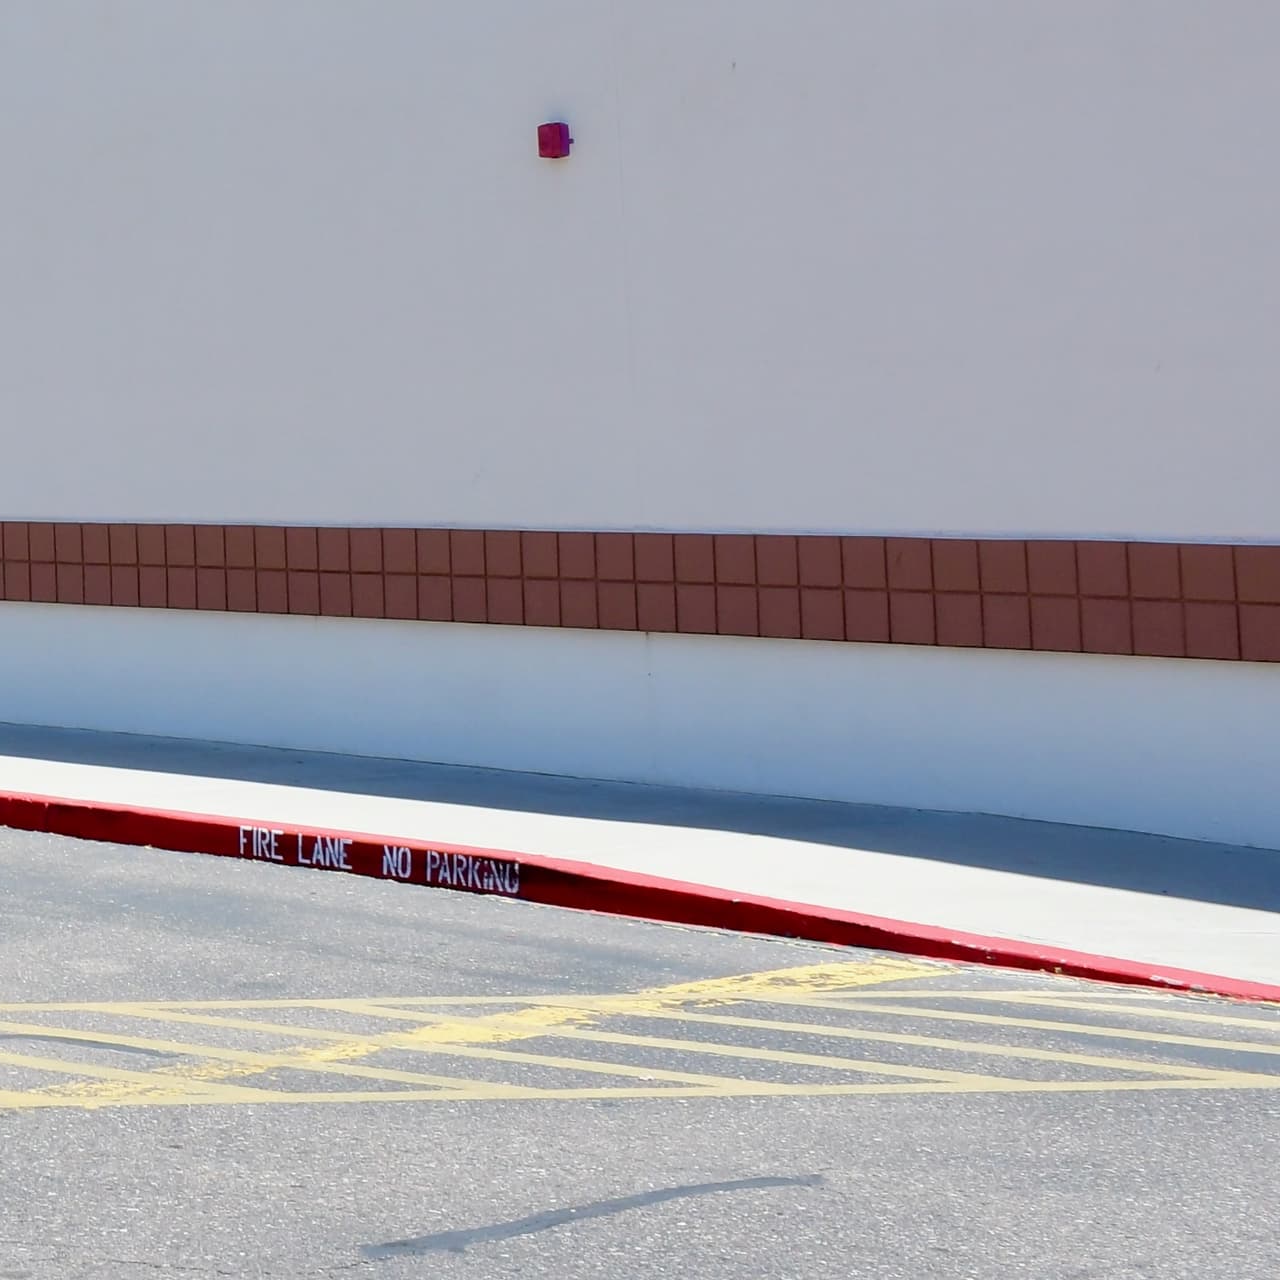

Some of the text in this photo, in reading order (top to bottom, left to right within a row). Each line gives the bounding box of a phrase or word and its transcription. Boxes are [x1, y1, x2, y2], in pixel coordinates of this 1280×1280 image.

[239, 825, 520, 894] FIRE LANE NO PARKING
